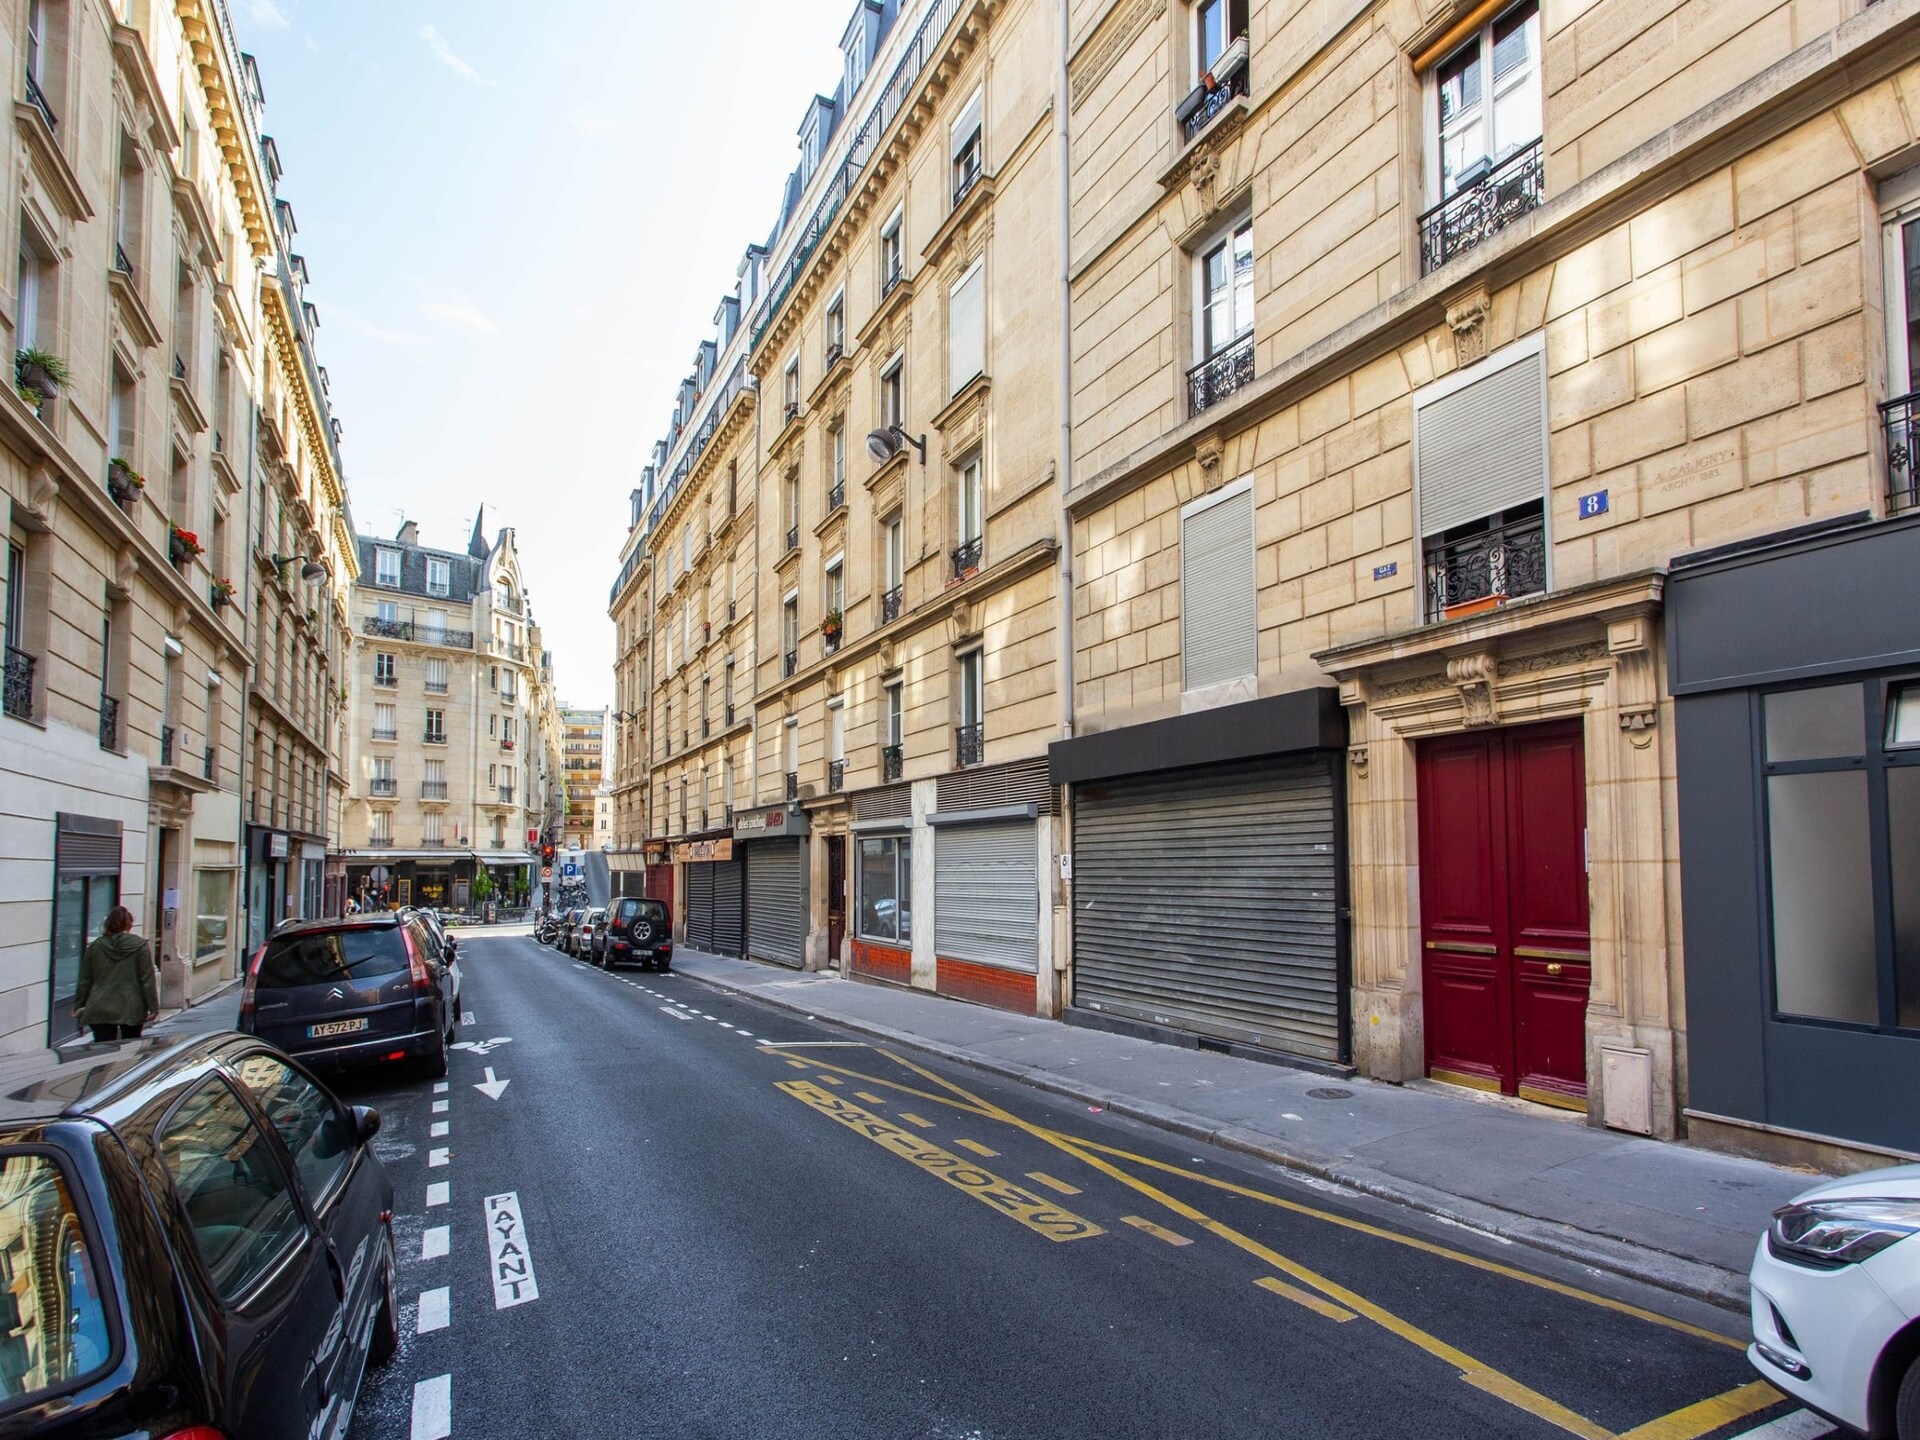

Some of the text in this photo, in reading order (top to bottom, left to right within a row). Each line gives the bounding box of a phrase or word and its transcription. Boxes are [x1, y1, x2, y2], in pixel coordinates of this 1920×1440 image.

[1587, 495, 1599, 513] 8
[566, 865, 574, 874] P
[785, 1081, 1089, 1236] LIVRAISONS
[490, 1196, 529, 1301] PAYANT
